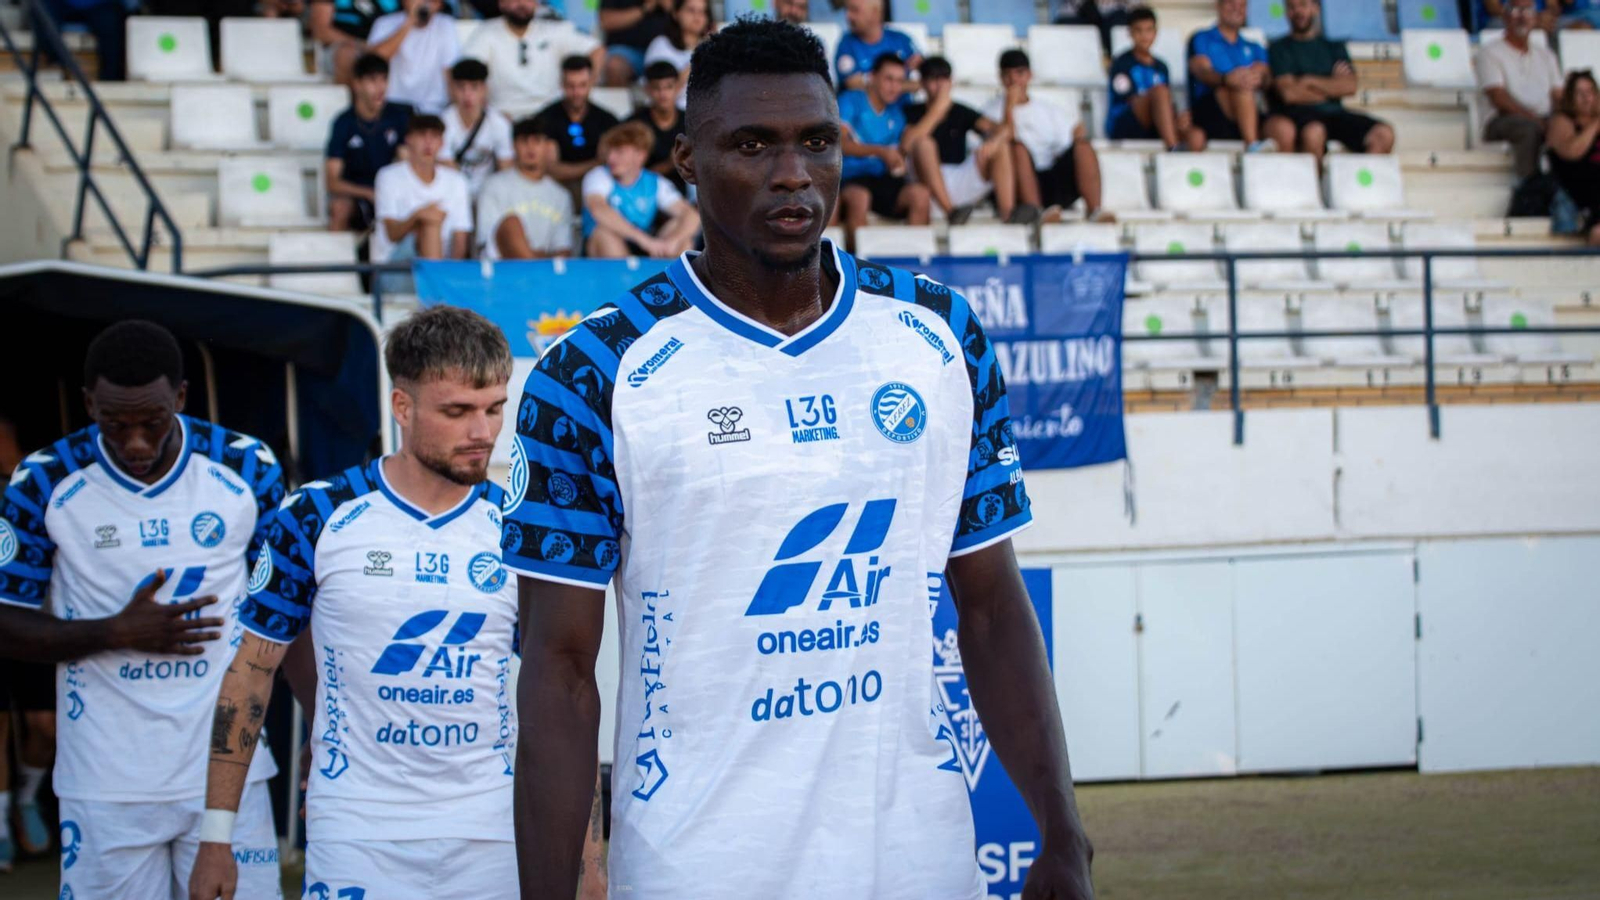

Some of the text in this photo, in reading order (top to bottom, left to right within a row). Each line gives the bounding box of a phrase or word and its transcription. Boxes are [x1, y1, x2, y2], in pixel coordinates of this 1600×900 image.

[786, 394, 837, 428] L3G
[708, 428, 751, 445] hummel
[792, 426, 840, 443] MARKETING.
[139, 519, 169, 538] L3G
[416, 552, 449, 574] L3G
[817, 556, 891, 611] Air
[119, 659, 208, 680] datono
[421, 646, 481, 678] Air
[378, 684, 474, 704] oneair.es
[376, 719, 478, 746] datono
